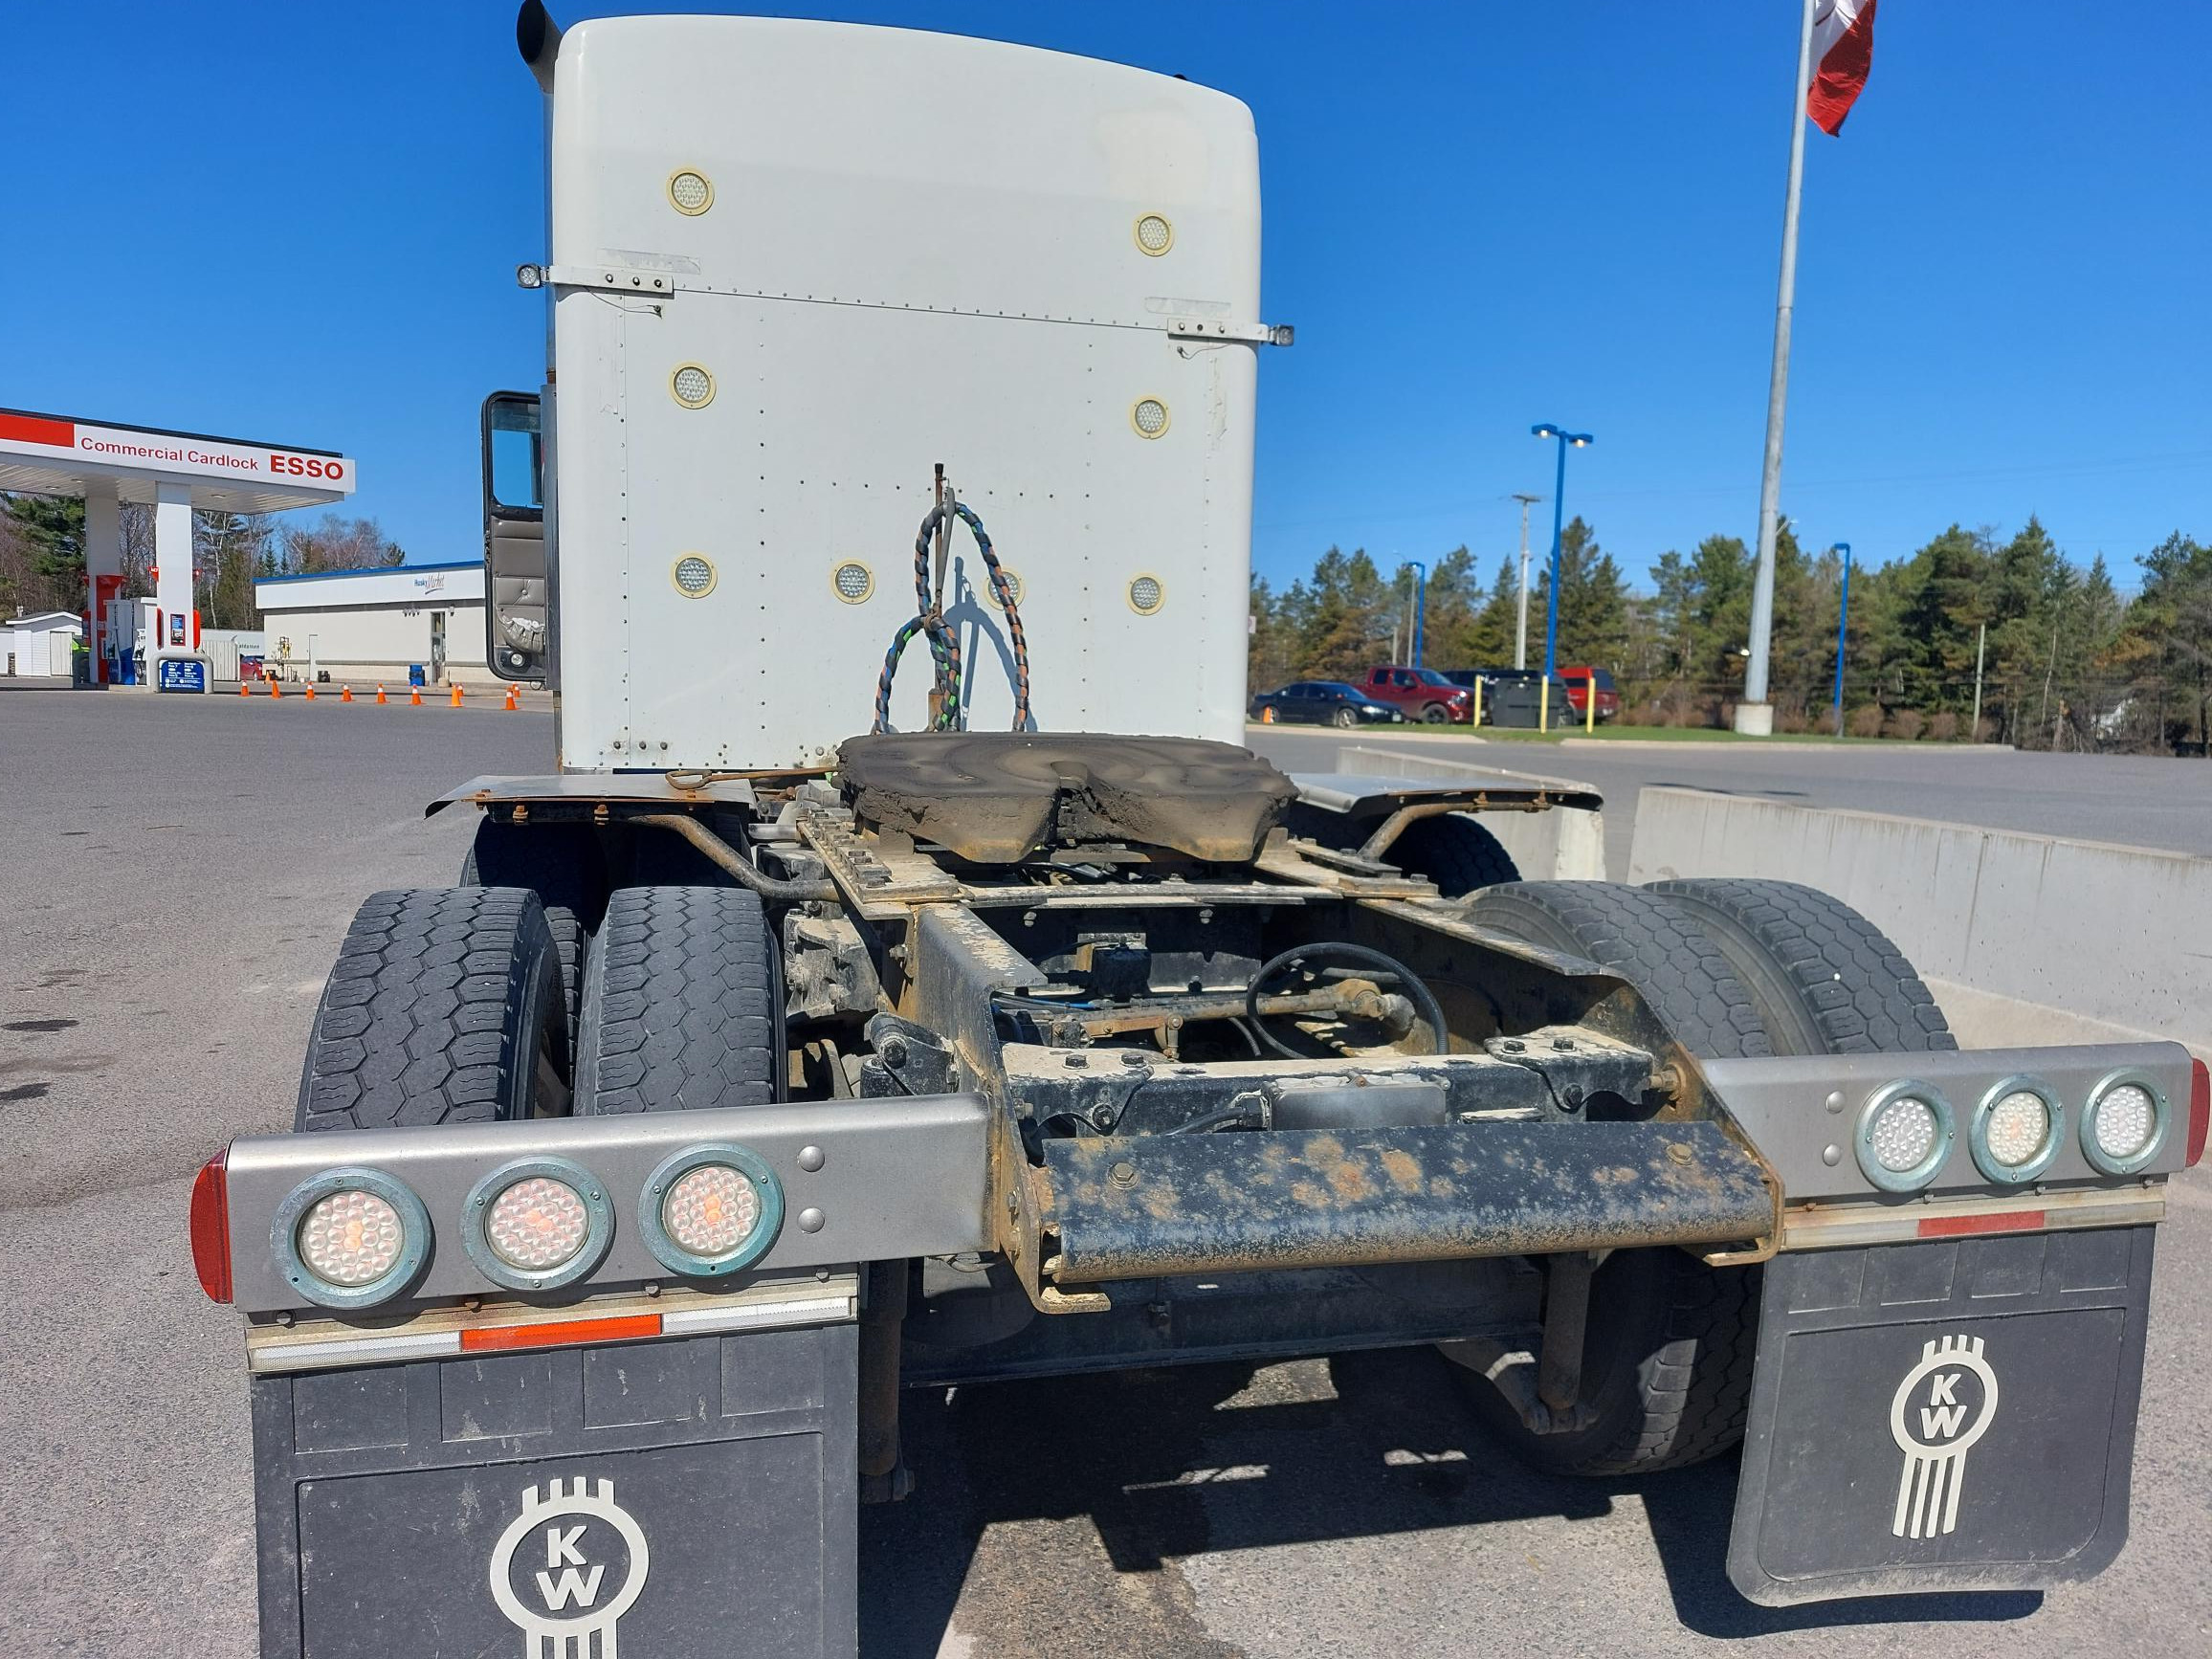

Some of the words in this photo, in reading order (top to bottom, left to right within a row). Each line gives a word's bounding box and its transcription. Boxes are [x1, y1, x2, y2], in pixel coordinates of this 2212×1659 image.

[80, 437, 183, 462] Commercial
[188, 451, 259, 471] Cardlock
[270, 454, 344, 480] ESSO
